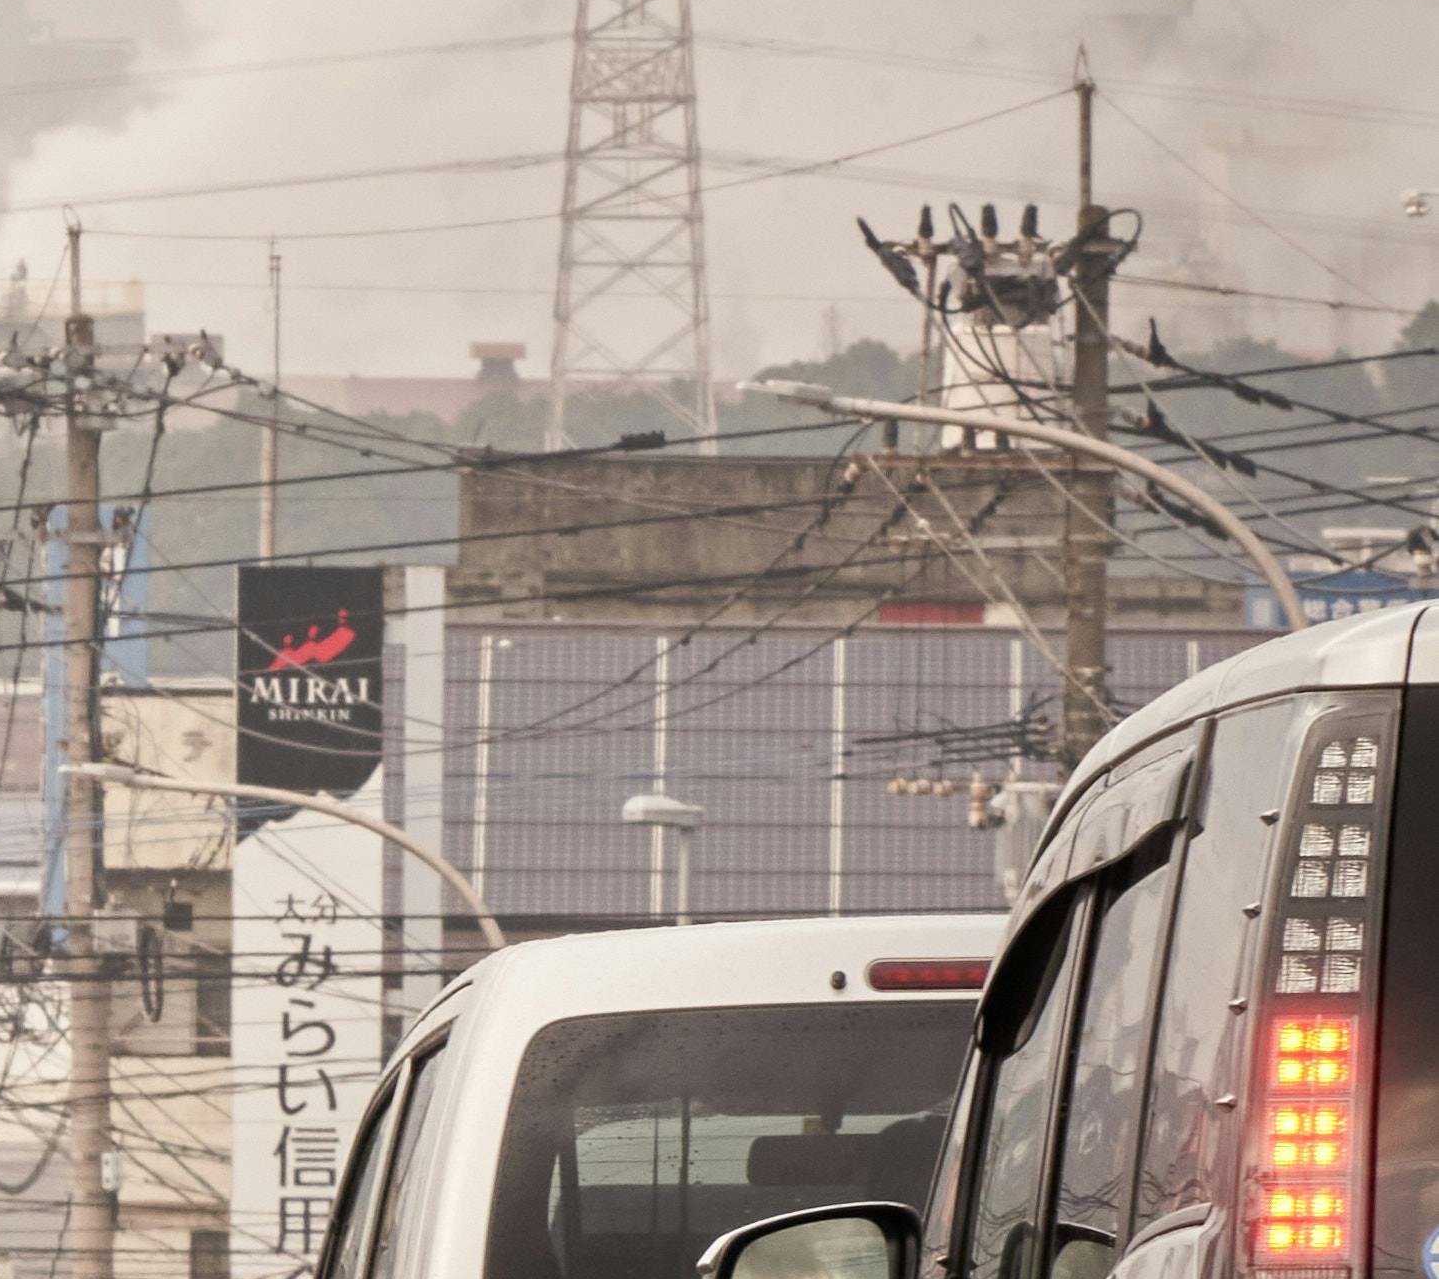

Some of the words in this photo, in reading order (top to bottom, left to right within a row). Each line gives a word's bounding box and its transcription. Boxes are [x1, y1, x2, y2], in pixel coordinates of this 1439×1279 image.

[250, 677, 370, 704] MIRAI
[268, 708, 351, 722] SHINKIN
[275, 892, 340, 926] 大分
